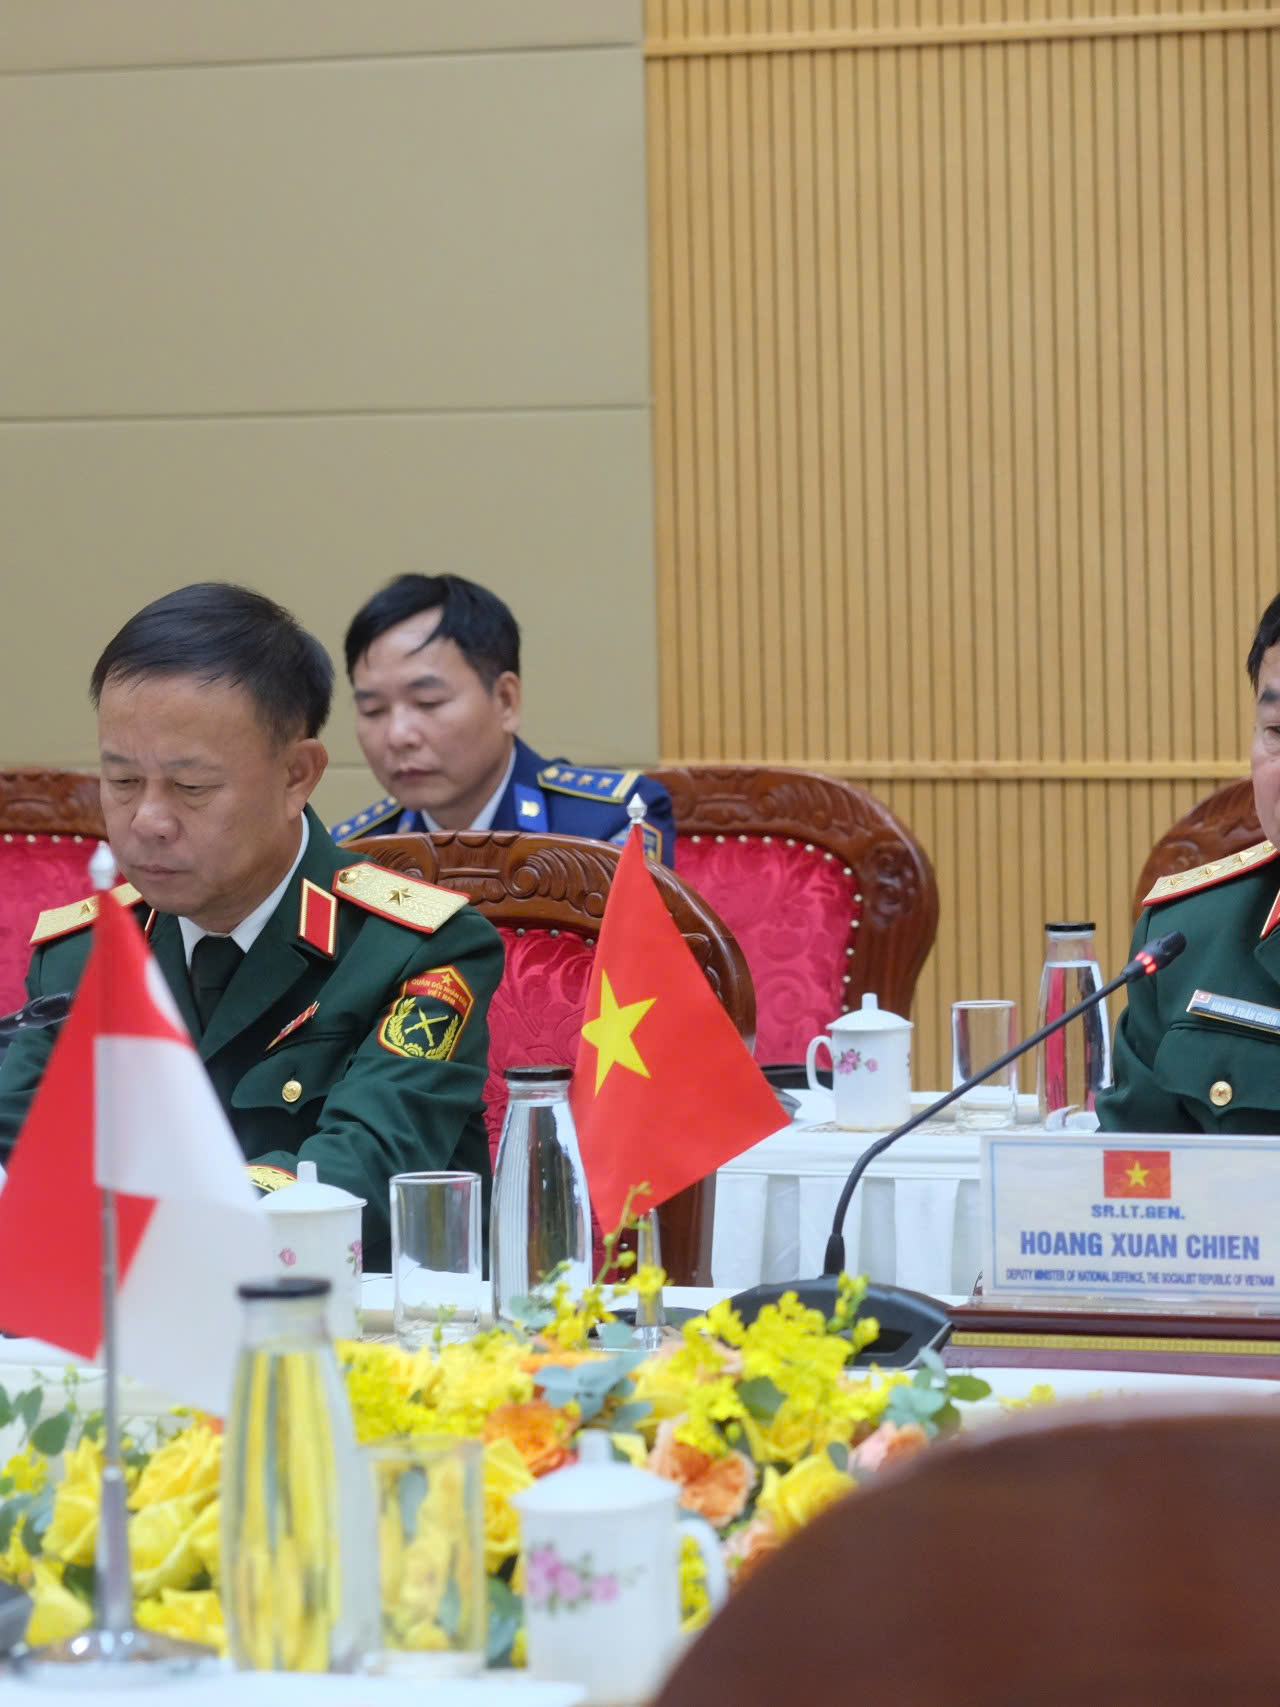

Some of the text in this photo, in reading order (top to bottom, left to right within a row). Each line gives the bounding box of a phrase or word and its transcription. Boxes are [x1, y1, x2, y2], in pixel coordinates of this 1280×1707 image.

[1091, 1204, 1185, 1220] SR.LT.GEN.
[1020, 1231, 1259, 1260] HOANG XUAN CHIEN
[1006, 1268, 1033, 1281] DEPUTY
[1034, 1269, 1064, 1281] MINISTER
[1066, 1269, 1076, 1281] OF
[1078, 1270, 1110, 1282] NATIONAL
[1147, 1272, 1159, 1284] THE
[1161, 1272, 1197, 1285] SOCIALIST
[1199, 1273, 1232, 1286] REPUBLIC
[1233, 1274, 1242, 1286] OF
[1244, 1275, 1275, 1287] VIETNAM
